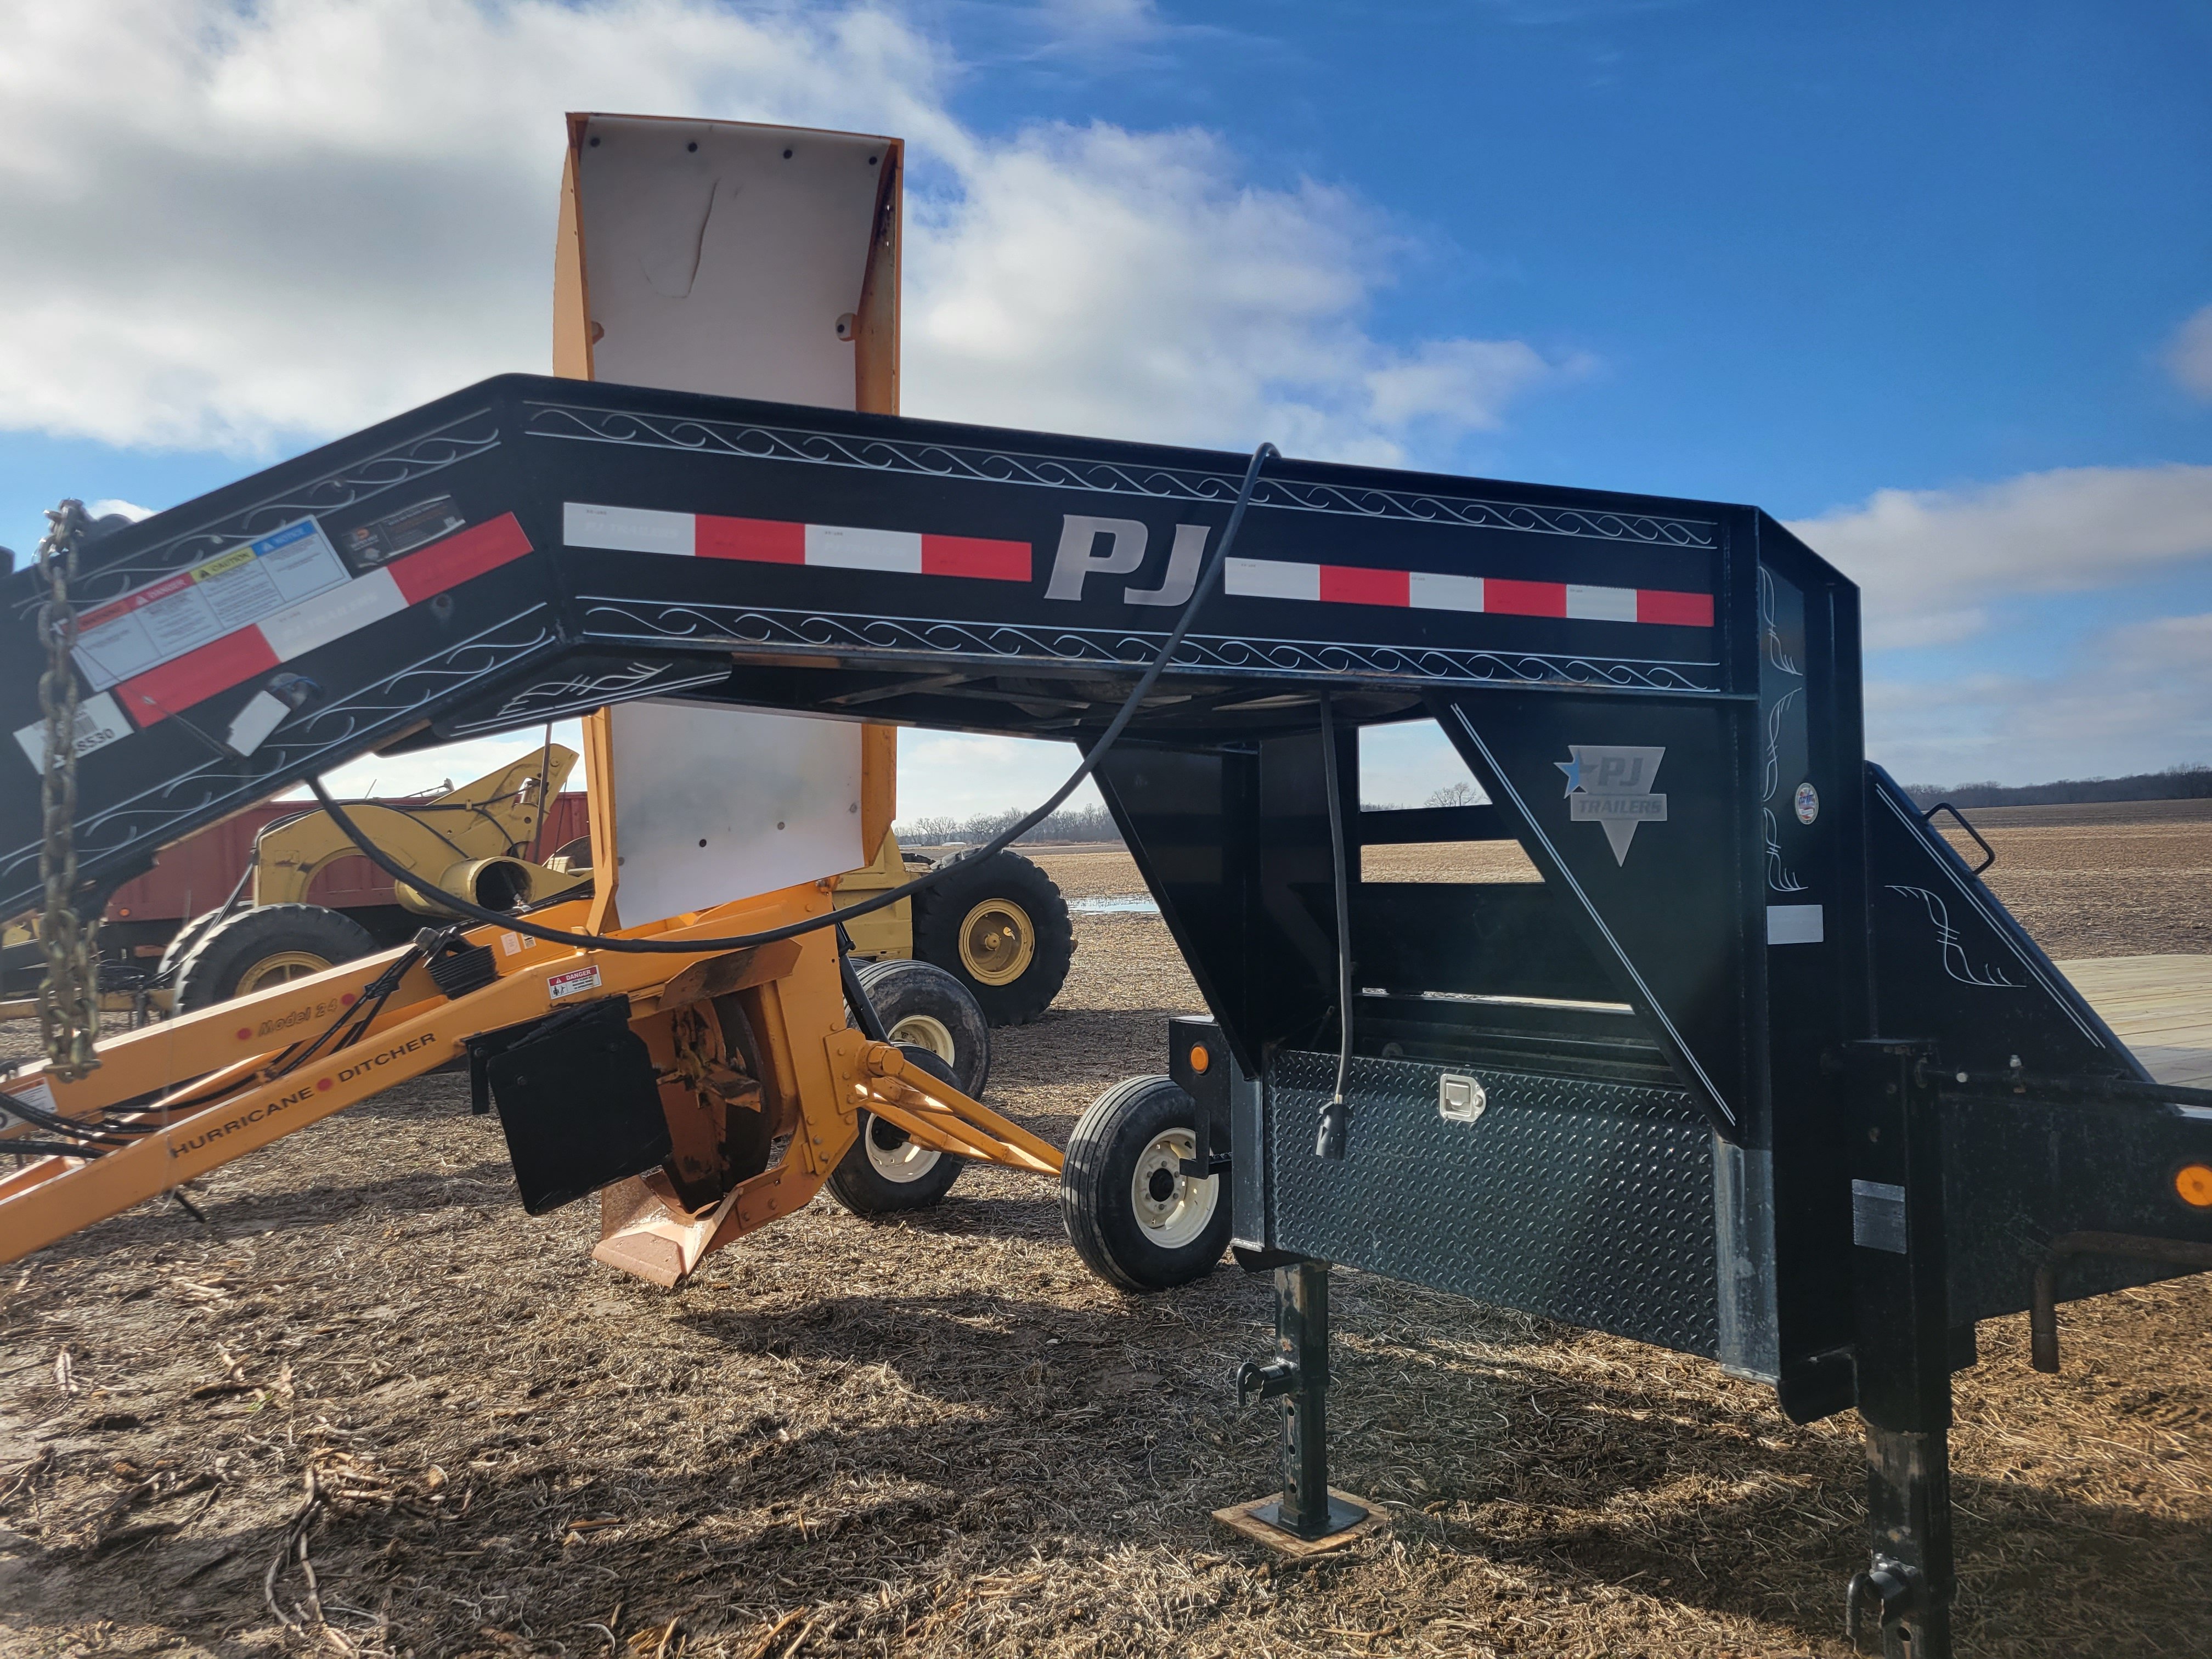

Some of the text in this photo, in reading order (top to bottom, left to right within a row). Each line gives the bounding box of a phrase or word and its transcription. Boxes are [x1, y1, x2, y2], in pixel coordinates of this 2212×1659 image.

[212, 552, 251, 572] CAUTION
[1044, 514, 1211, 606] PJ
[146, 578, 187, 600] DANGER
[1597, 757, 1644, 787] PJ
[1579, 800, 1662, 814] TRAILERS
[566, 969, 591, 981] DANGER
[258, 998, 338, 1037] Model 24
[169, 1032, 437, 1159] HURRICANE DITCHER
